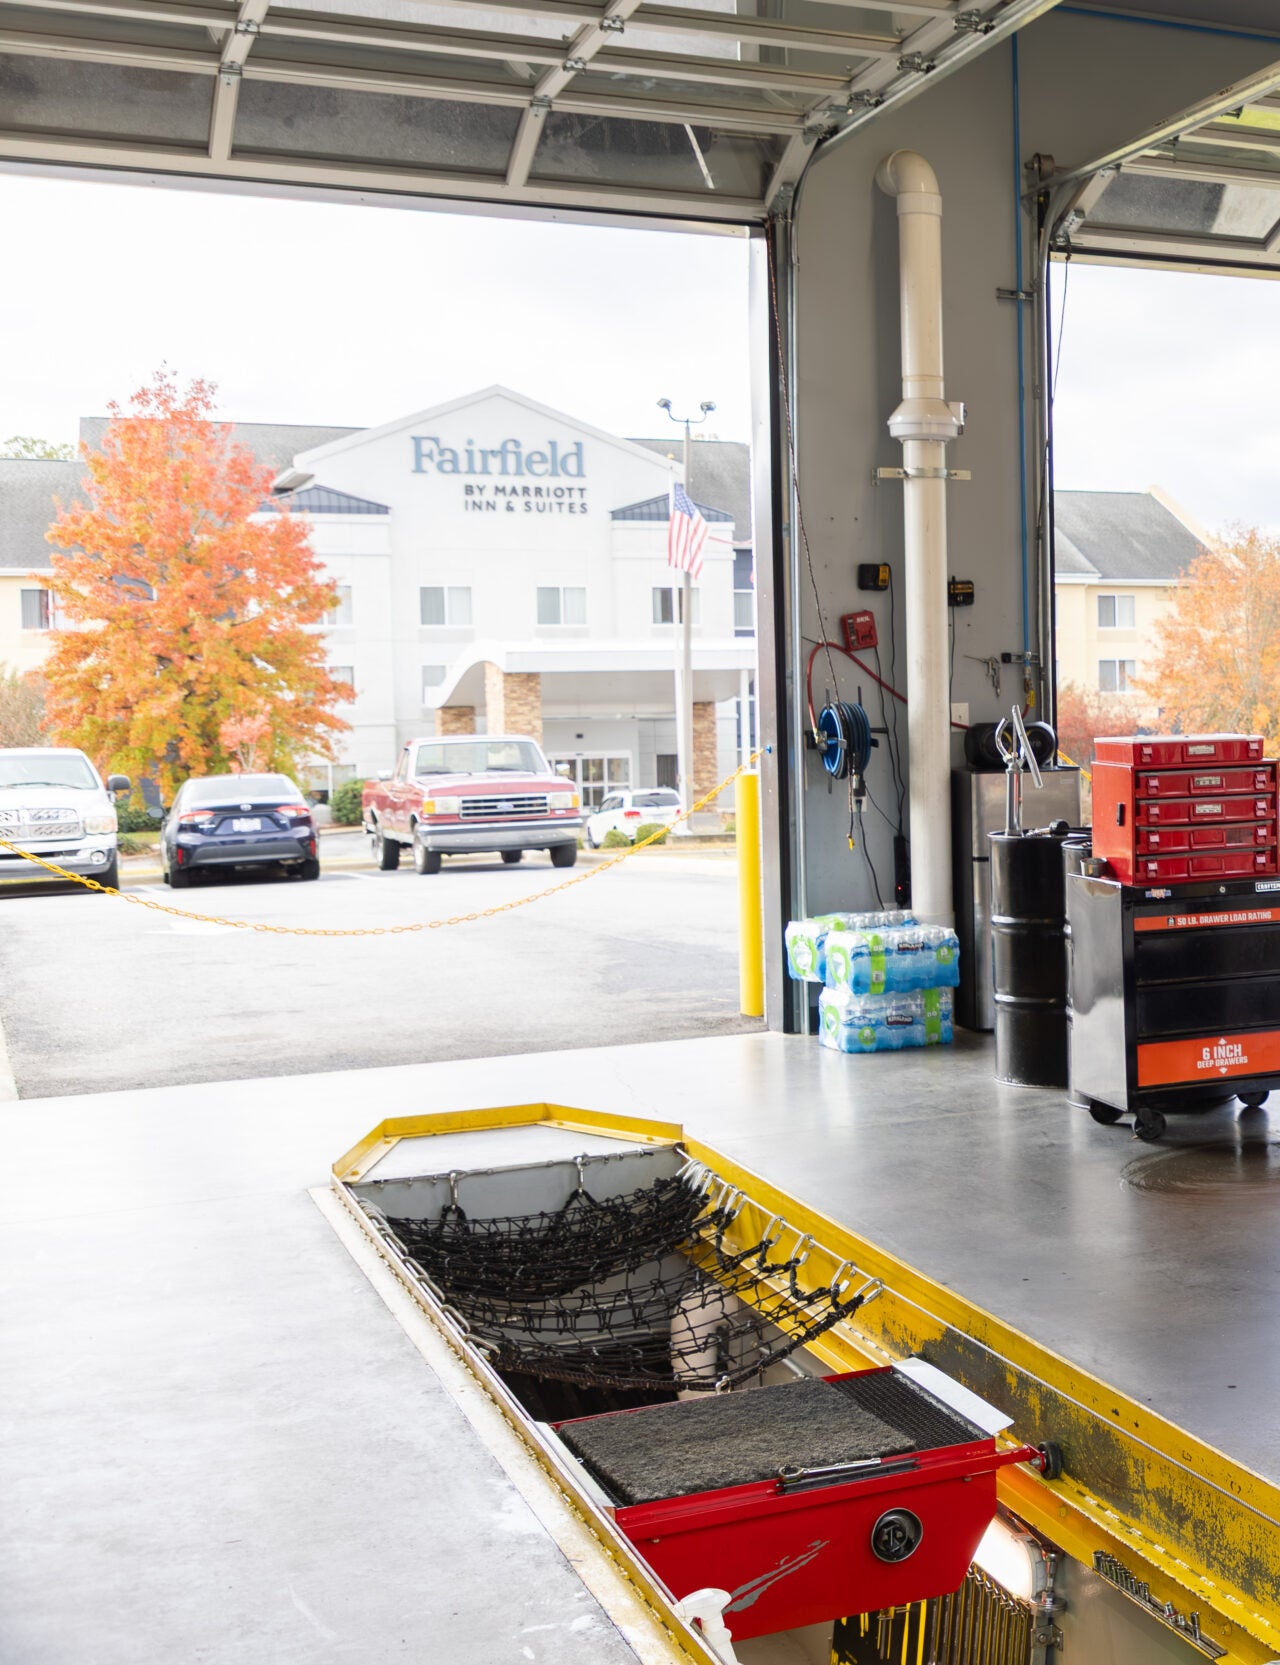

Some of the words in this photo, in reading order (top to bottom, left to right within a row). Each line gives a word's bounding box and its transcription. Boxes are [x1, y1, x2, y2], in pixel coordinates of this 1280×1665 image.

[411, 435, 587, 478] Fairfield
[464, 484, 487, 496] BY
[494, 485, 587, 499] MARRIOTT
[464, 500, 496, 512] INN
[505, 501, 516, 512] &
[523, 501, 588, 514] SUITES
[1177, 917, 1187, 926] 50
[1188, 916, 1199, 925] LB.
[1200, 914, 1229, 924] DRAWER
[1230, 912, 1247, 922] LOAD
[1248, 911, 1272, 921] RATING
[1202, 1047, 1211, 1060] 6
[1213, 1043, 1242, 1059] INCH
[1196, 1060, 1214, 1069] DEEP
[1215, 1055, 1249, 1067] DRAWERS
